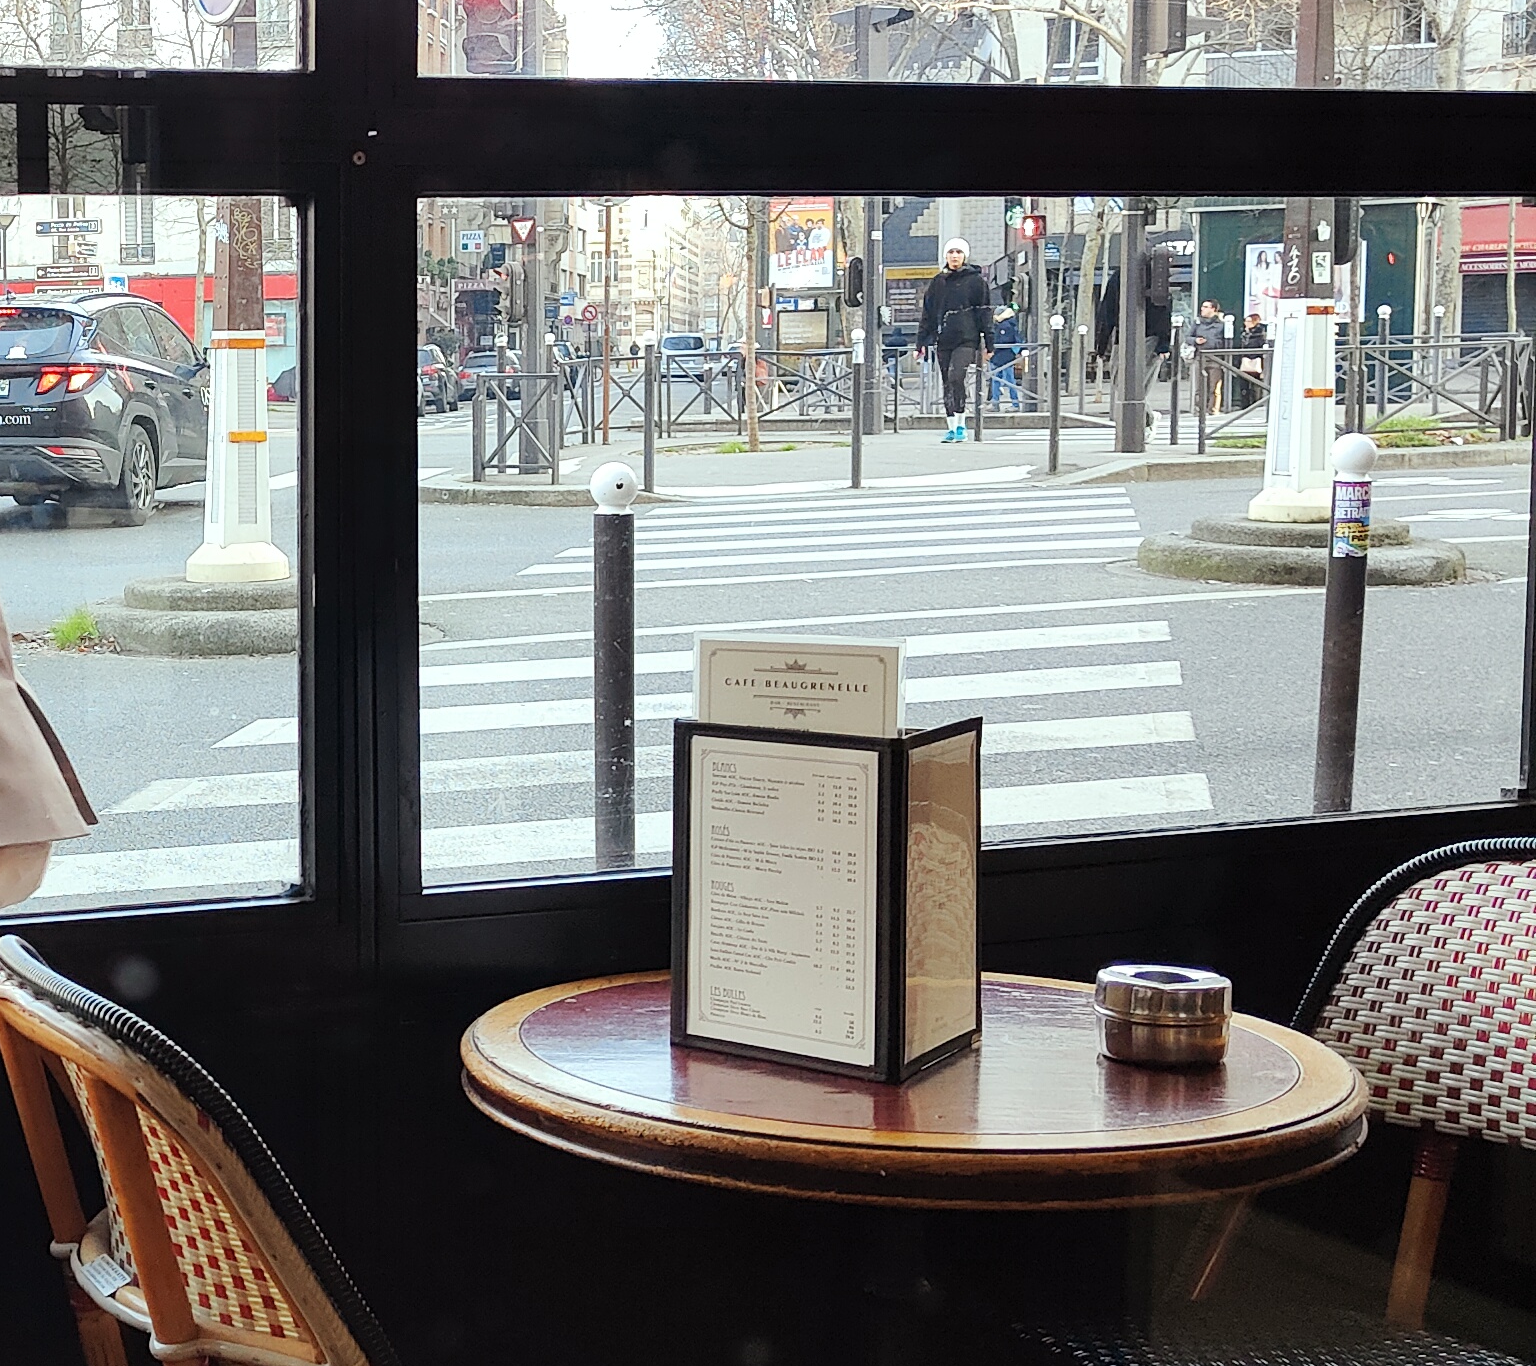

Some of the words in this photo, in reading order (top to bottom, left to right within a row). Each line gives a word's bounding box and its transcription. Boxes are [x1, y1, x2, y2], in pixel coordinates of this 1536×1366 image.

[461, 233, 482, 241] PIZZA
[777, 251, 792, 267] LE
[1335, 486, 1370, 501] MARC
[724, 677, 756, 688] CAFE
[765, 680, 869, 693] BEAUGRENELLE
[712, 761, 737, 773] BLANCS
[710, 880, 735, 893] ROUGES
[710, 985, 721, 997] LES
[723, 987, 746, 1001] BULLES
